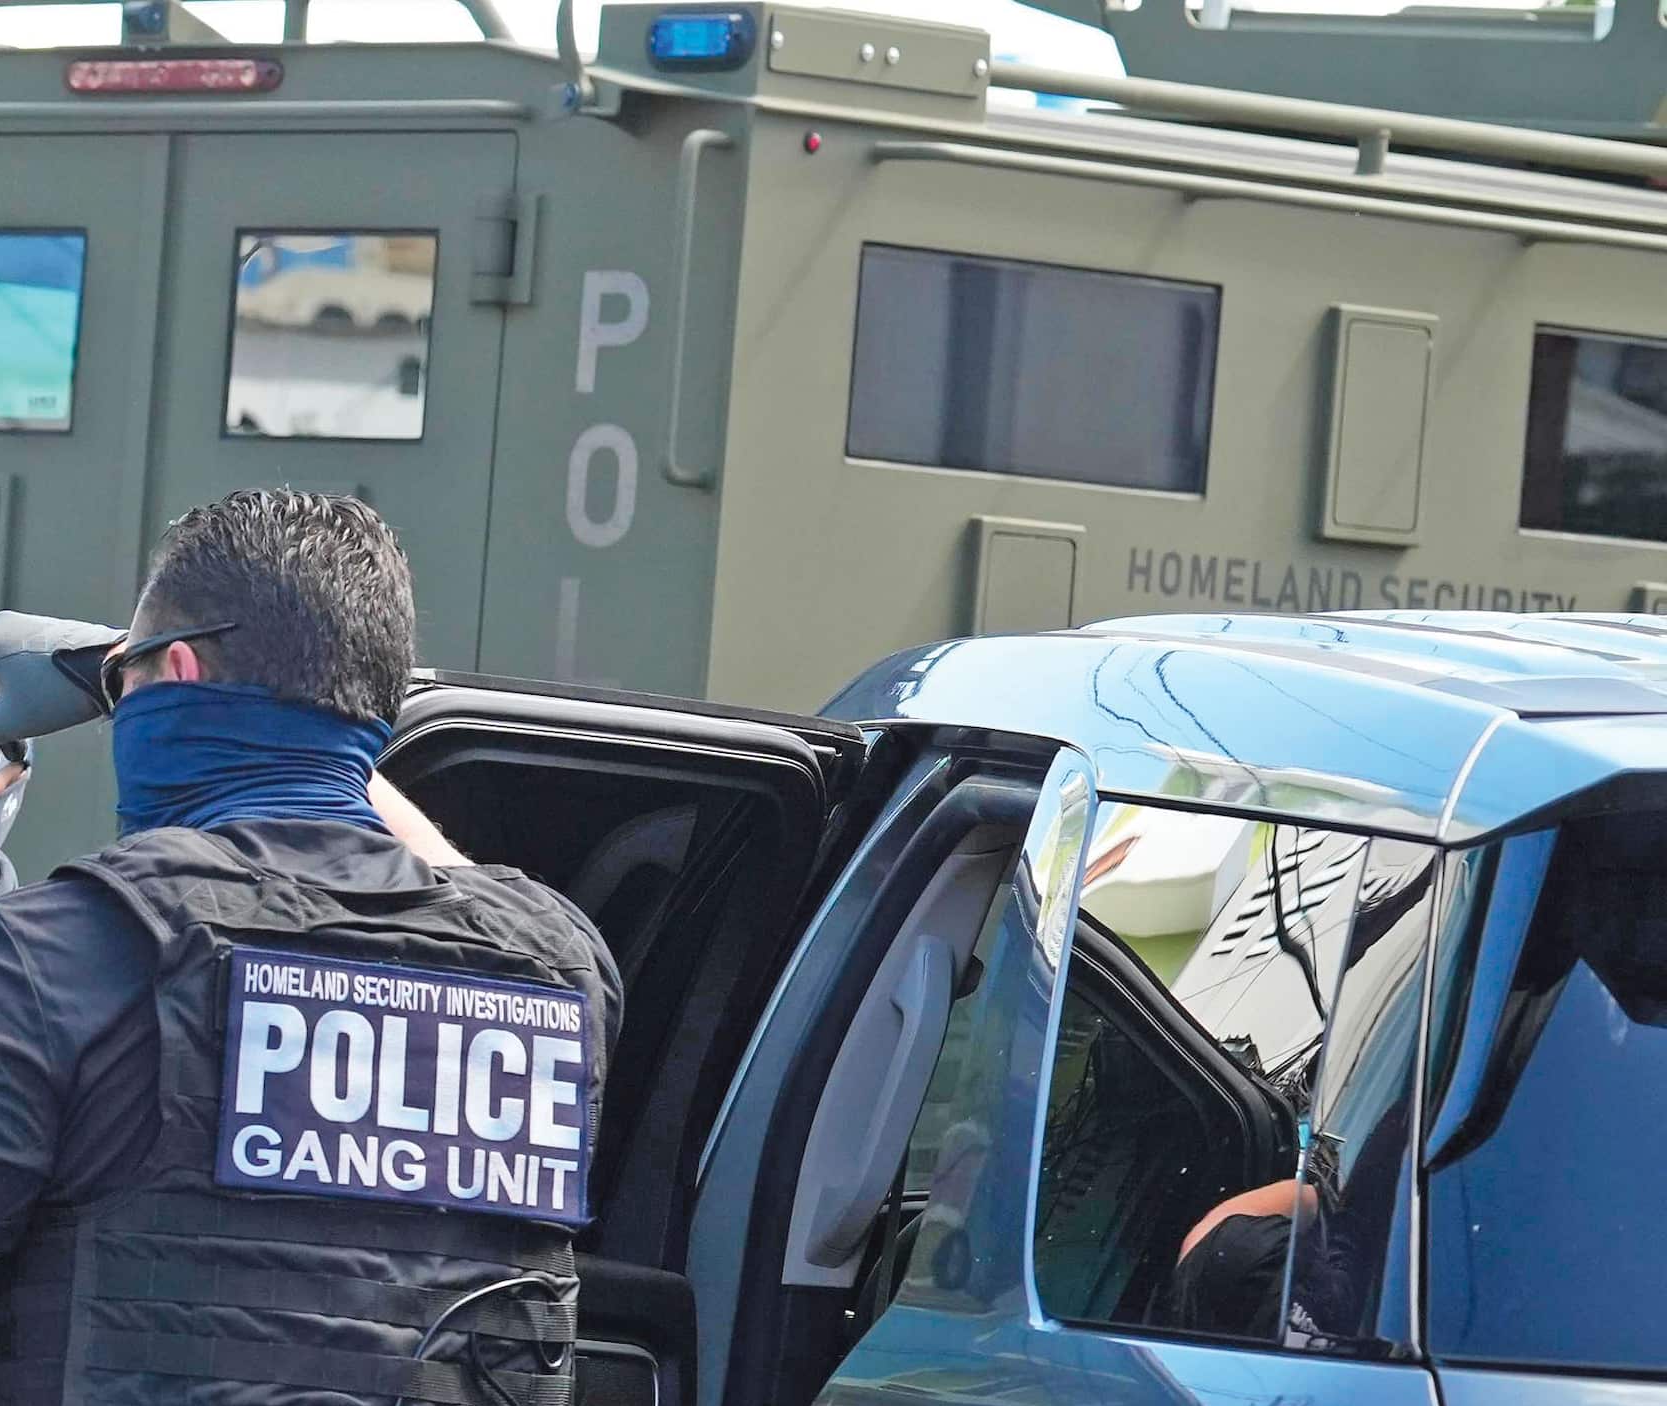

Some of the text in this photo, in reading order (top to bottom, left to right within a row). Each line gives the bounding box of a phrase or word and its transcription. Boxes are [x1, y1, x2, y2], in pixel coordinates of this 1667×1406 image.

[555, 270, 651, 690] POL
[1127, 547, 1363, 612] HOMELAND
[245, 962, 580, 1033] HOMELAND SECURITY INVESTIGATIONS
[235, 1000, 582, 1150] POLICE
[231, 1124, 578, 1210] GANG UNIT
